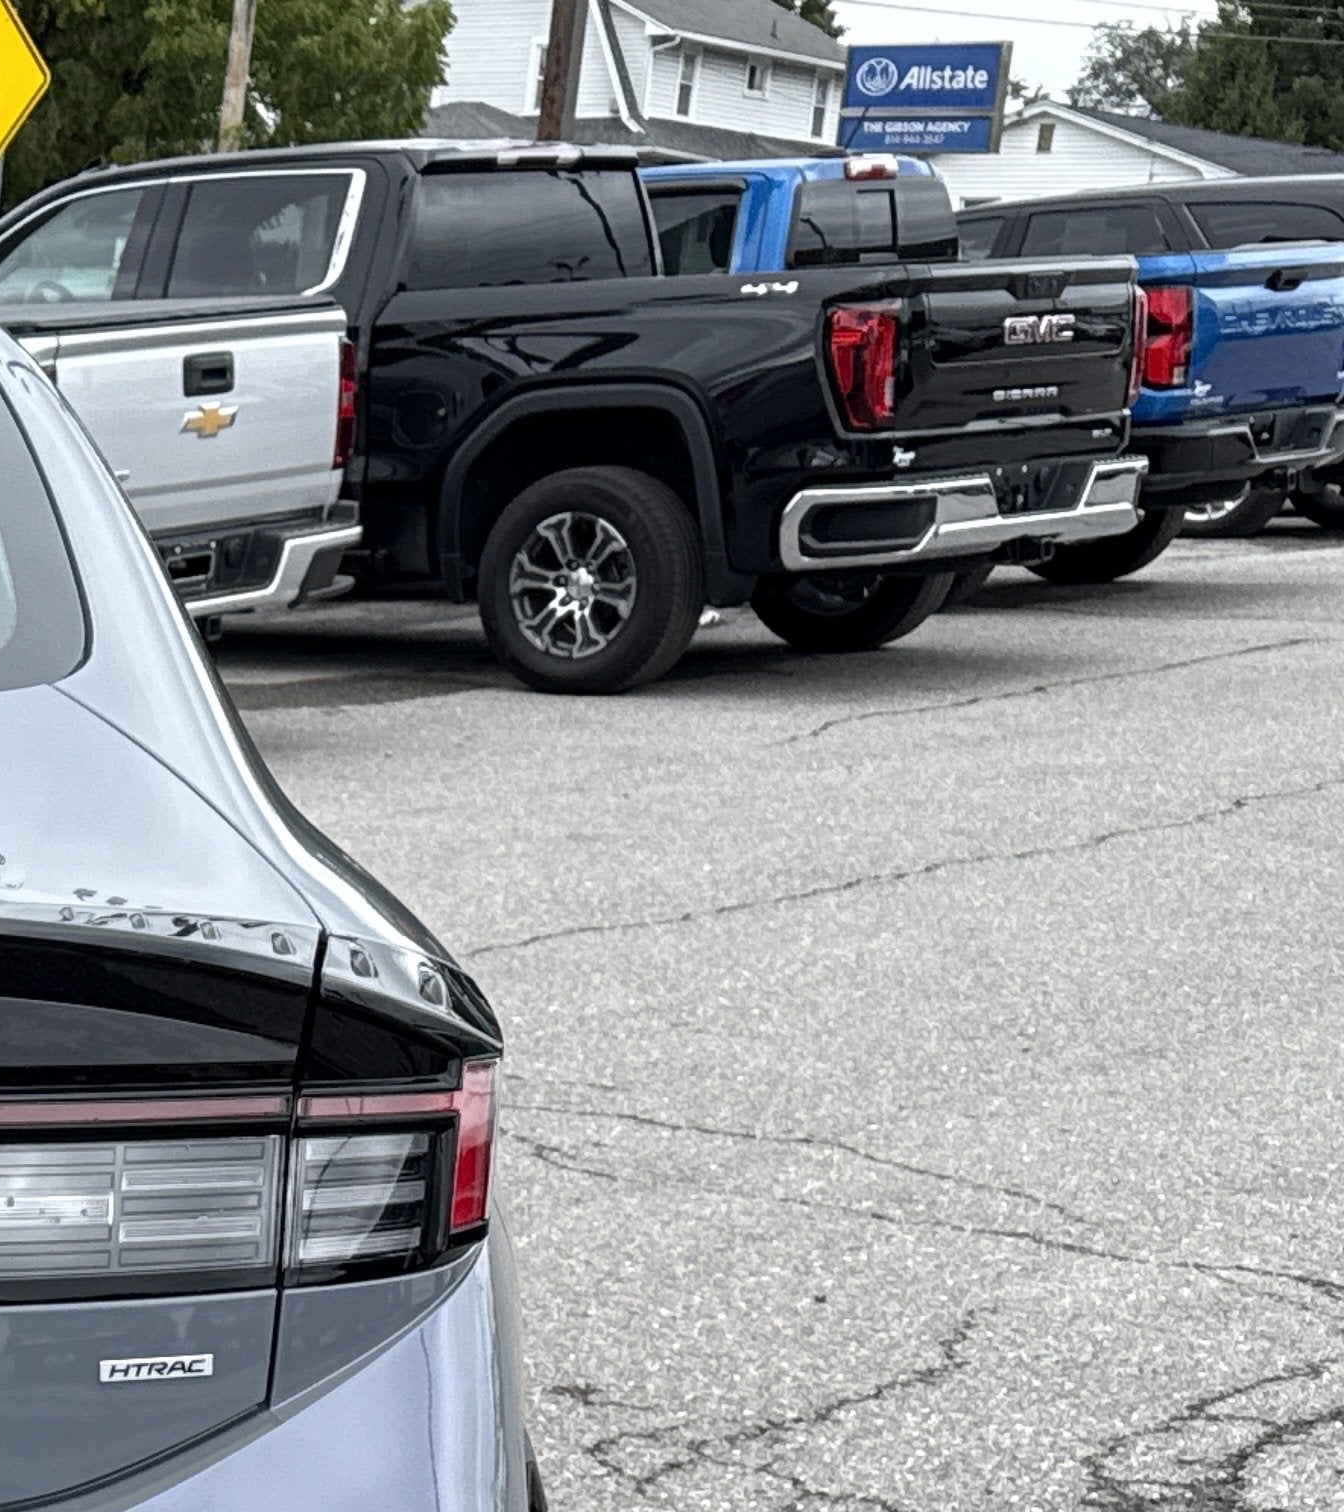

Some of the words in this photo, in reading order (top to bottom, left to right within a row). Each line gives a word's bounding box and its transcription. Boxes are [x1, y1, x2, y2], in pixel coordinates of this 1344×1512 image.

[898, 65, 989, 91] Allstate
[1004, 314, 1075, 345] GMC
[108, 1358, 207, 1378] HTRAC
